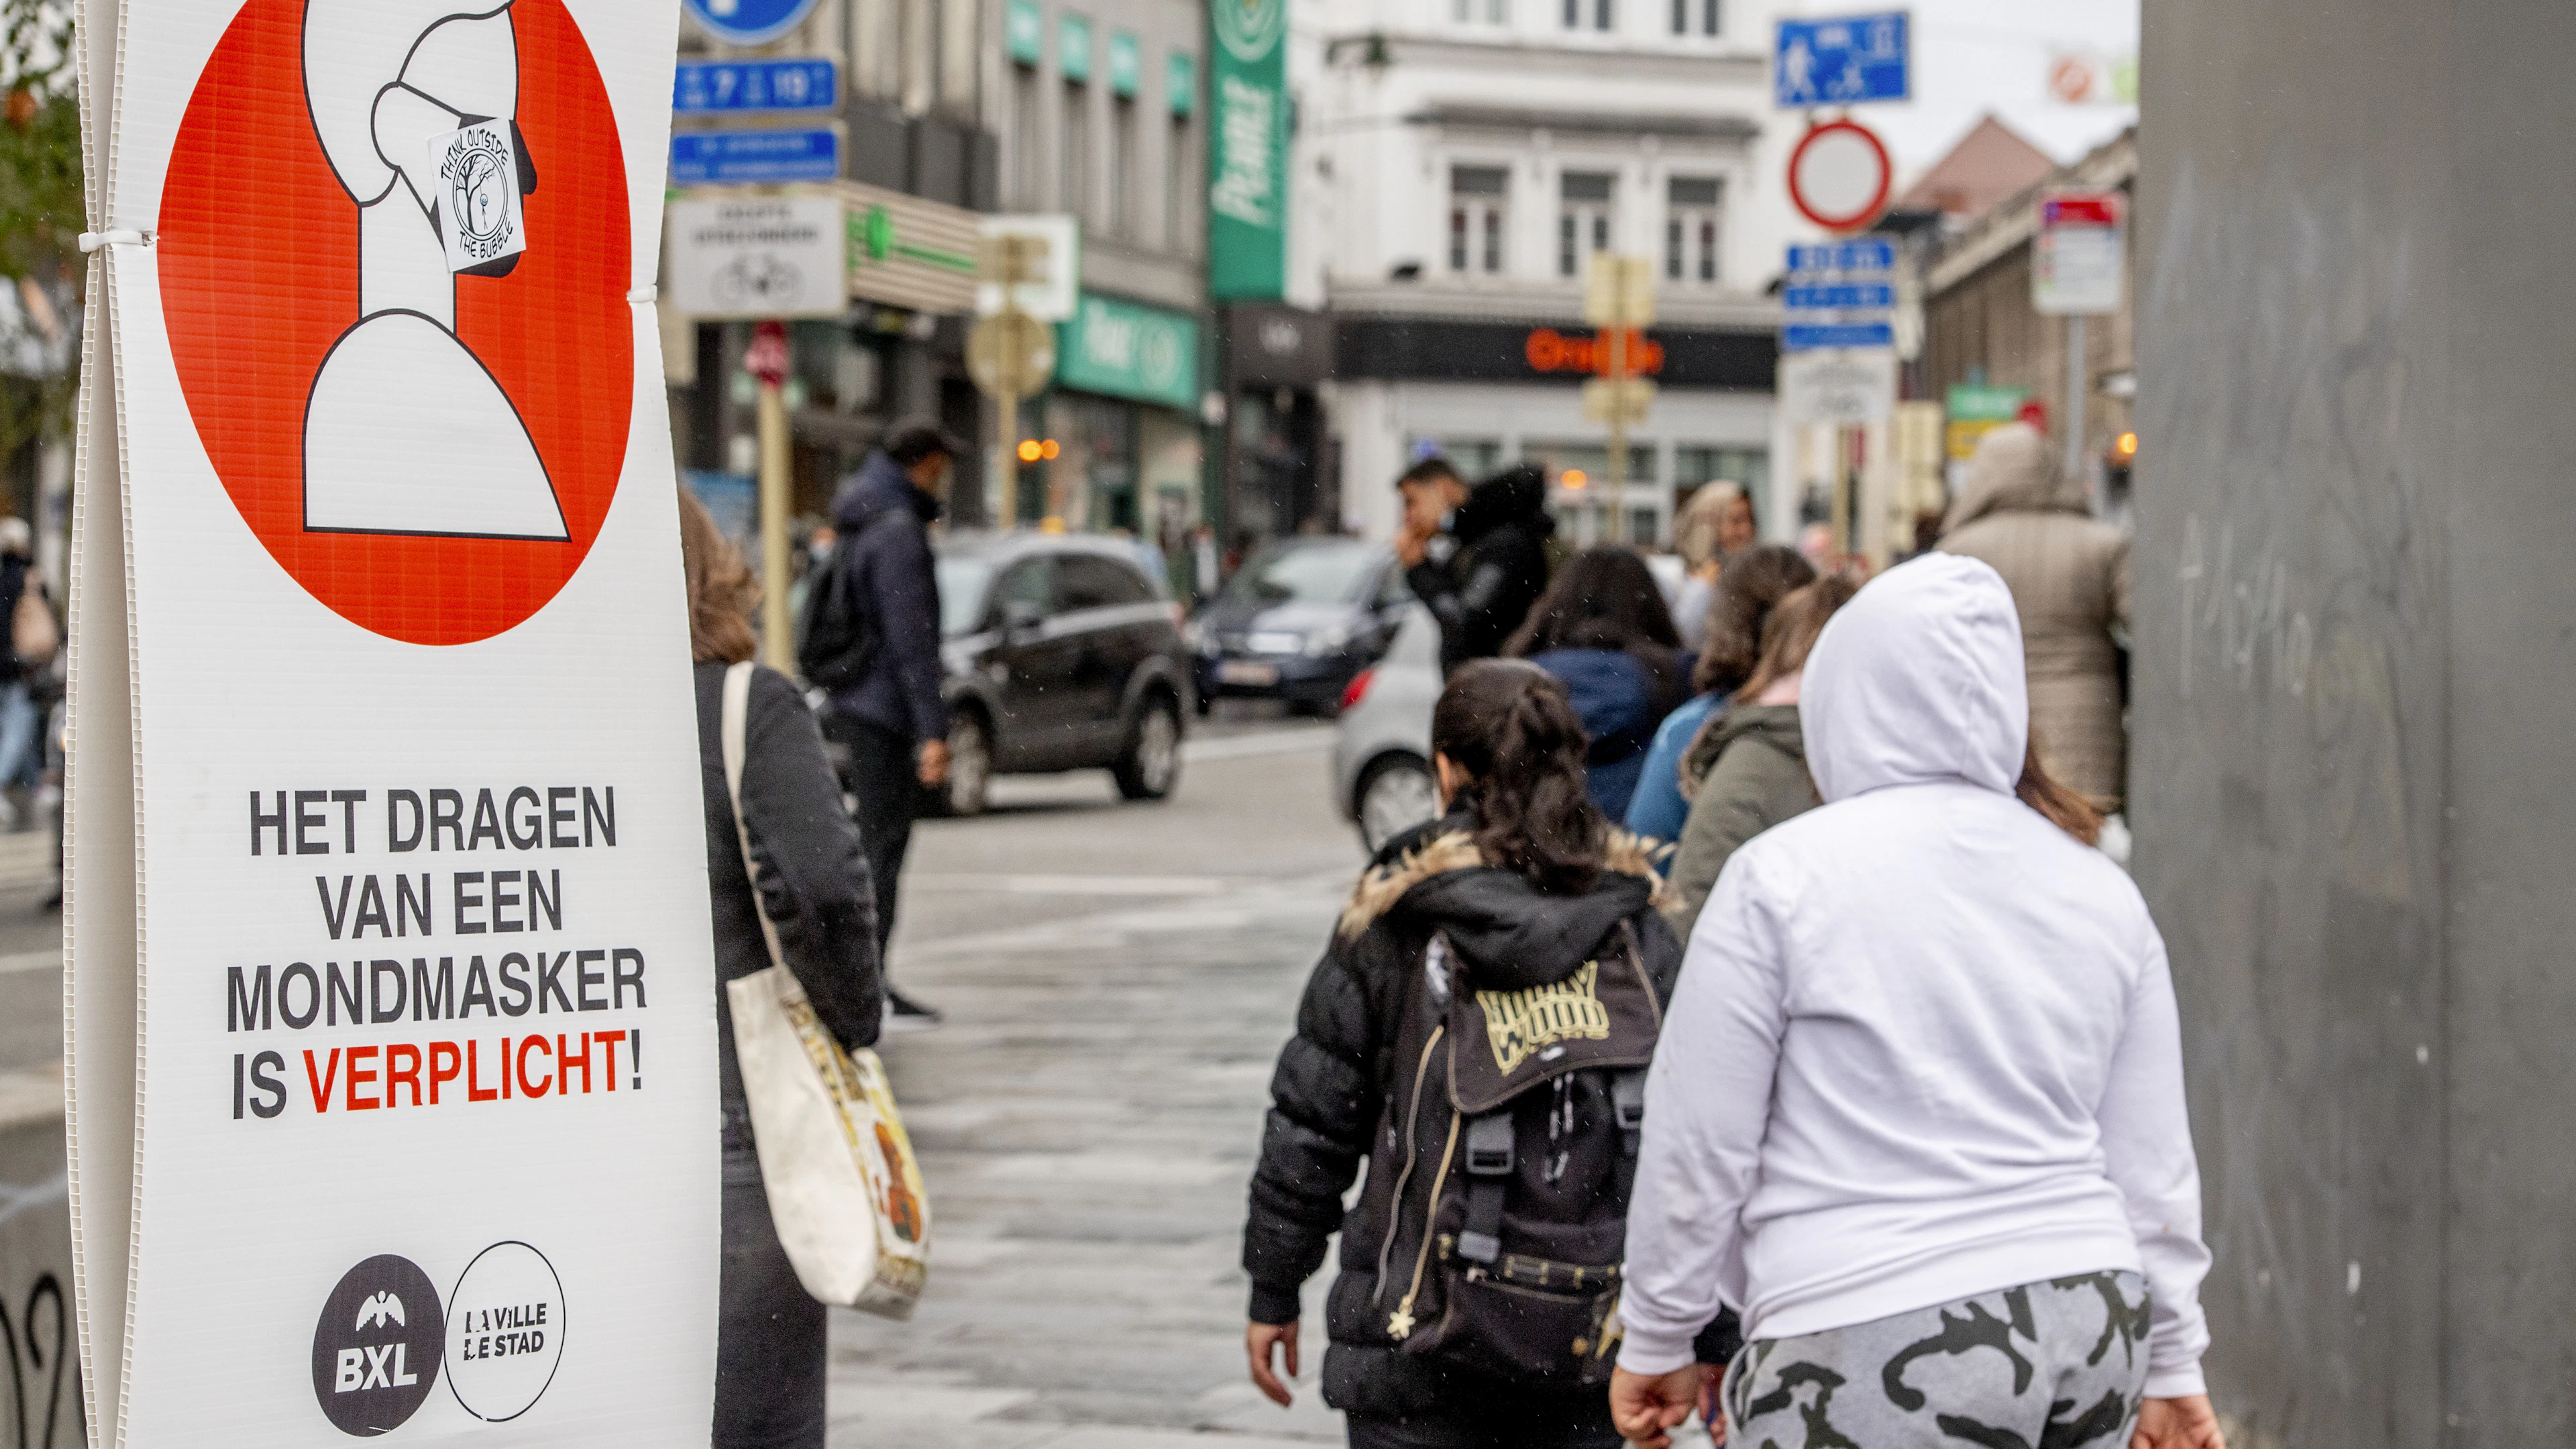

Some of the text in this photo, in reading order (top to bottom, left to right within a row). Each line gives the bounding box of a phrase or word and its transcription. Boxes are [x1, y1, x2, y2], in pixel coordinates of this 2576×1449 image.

[441, 128, 508, 180] THINK OUTSIDE
[460, 217, 513, 258] THE BUBBLE
[250, 786, 616, 855] HET DRAGEN
[315, 869, 562, 940] VAN EEN
[227, 948, 647, 1032] MONDMASKER
[233, 1029, 641, 1120] IS VERPLICHT!
[466, 1303, 547, 1333] LA VILLE
[335, 1343, 417, 1393] BXL
[464, 1331, 544, 1360] DE STAD
